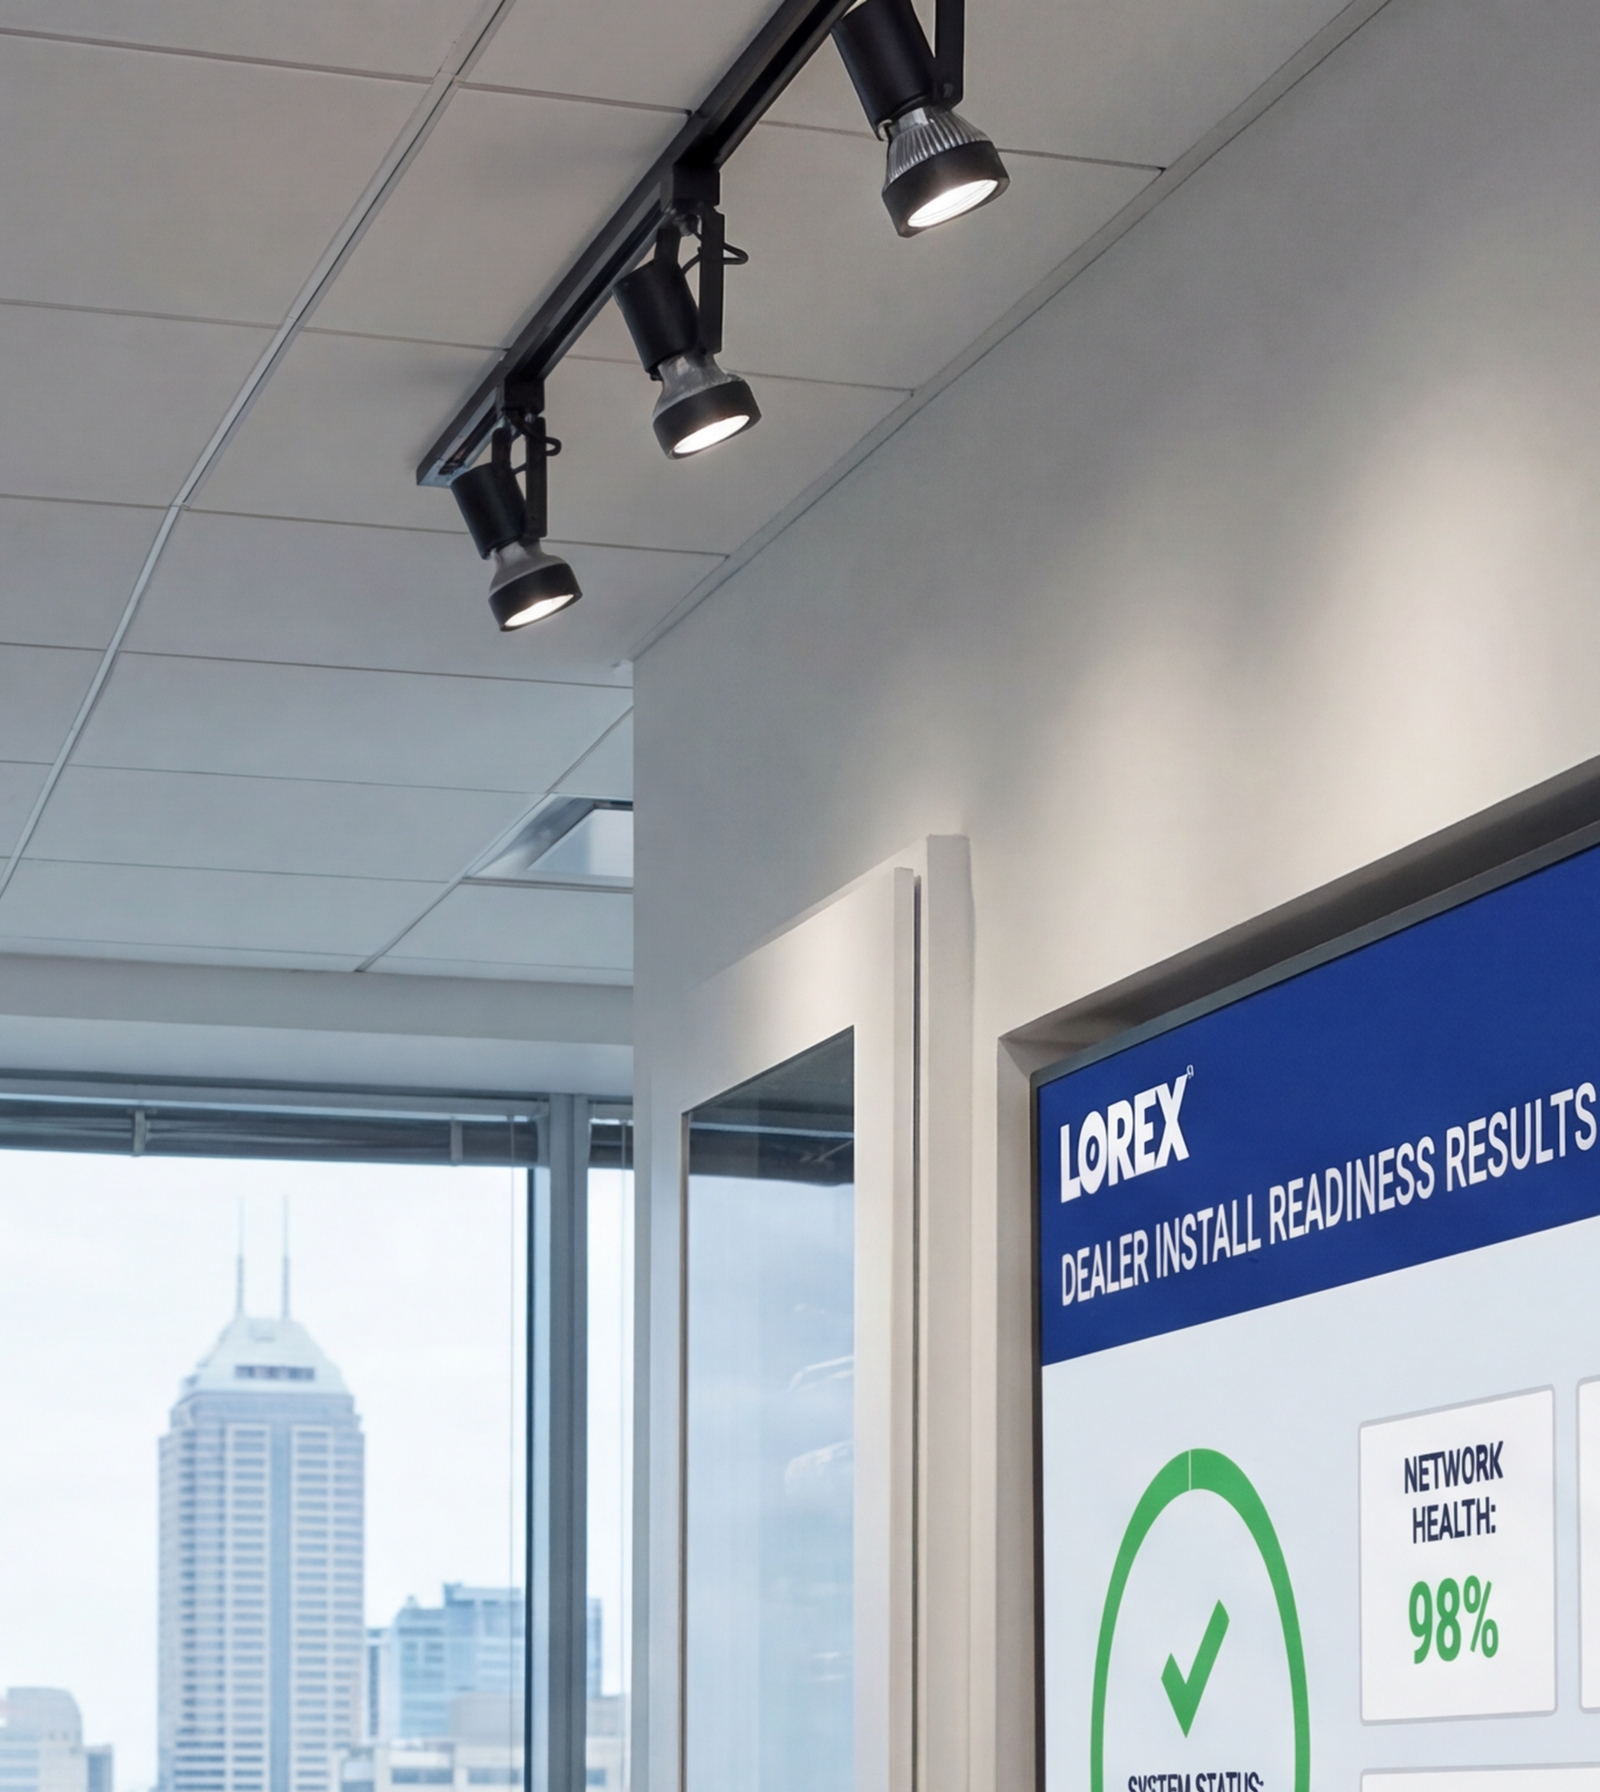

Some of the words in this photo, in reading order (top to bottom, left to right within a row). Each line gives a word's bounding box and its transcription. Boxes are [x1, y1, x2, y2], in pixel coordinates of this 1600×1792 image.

[1060, 1074, 1190, 1203] LOREX
[1062, 1230, 1149, 1306] DEALER
[1156, 1194, 1261, 1278] INSTALL
[1270, 1136, 1434, 1244] READINESS
[1447, 1081, 1596, 1191] RESULTS
[1405, 1441, 1503, 1494] NETWORK
[1413, 1497, 1496, 1543] HEALTH:
[1409, 1575, 1498, 1664] 98%
